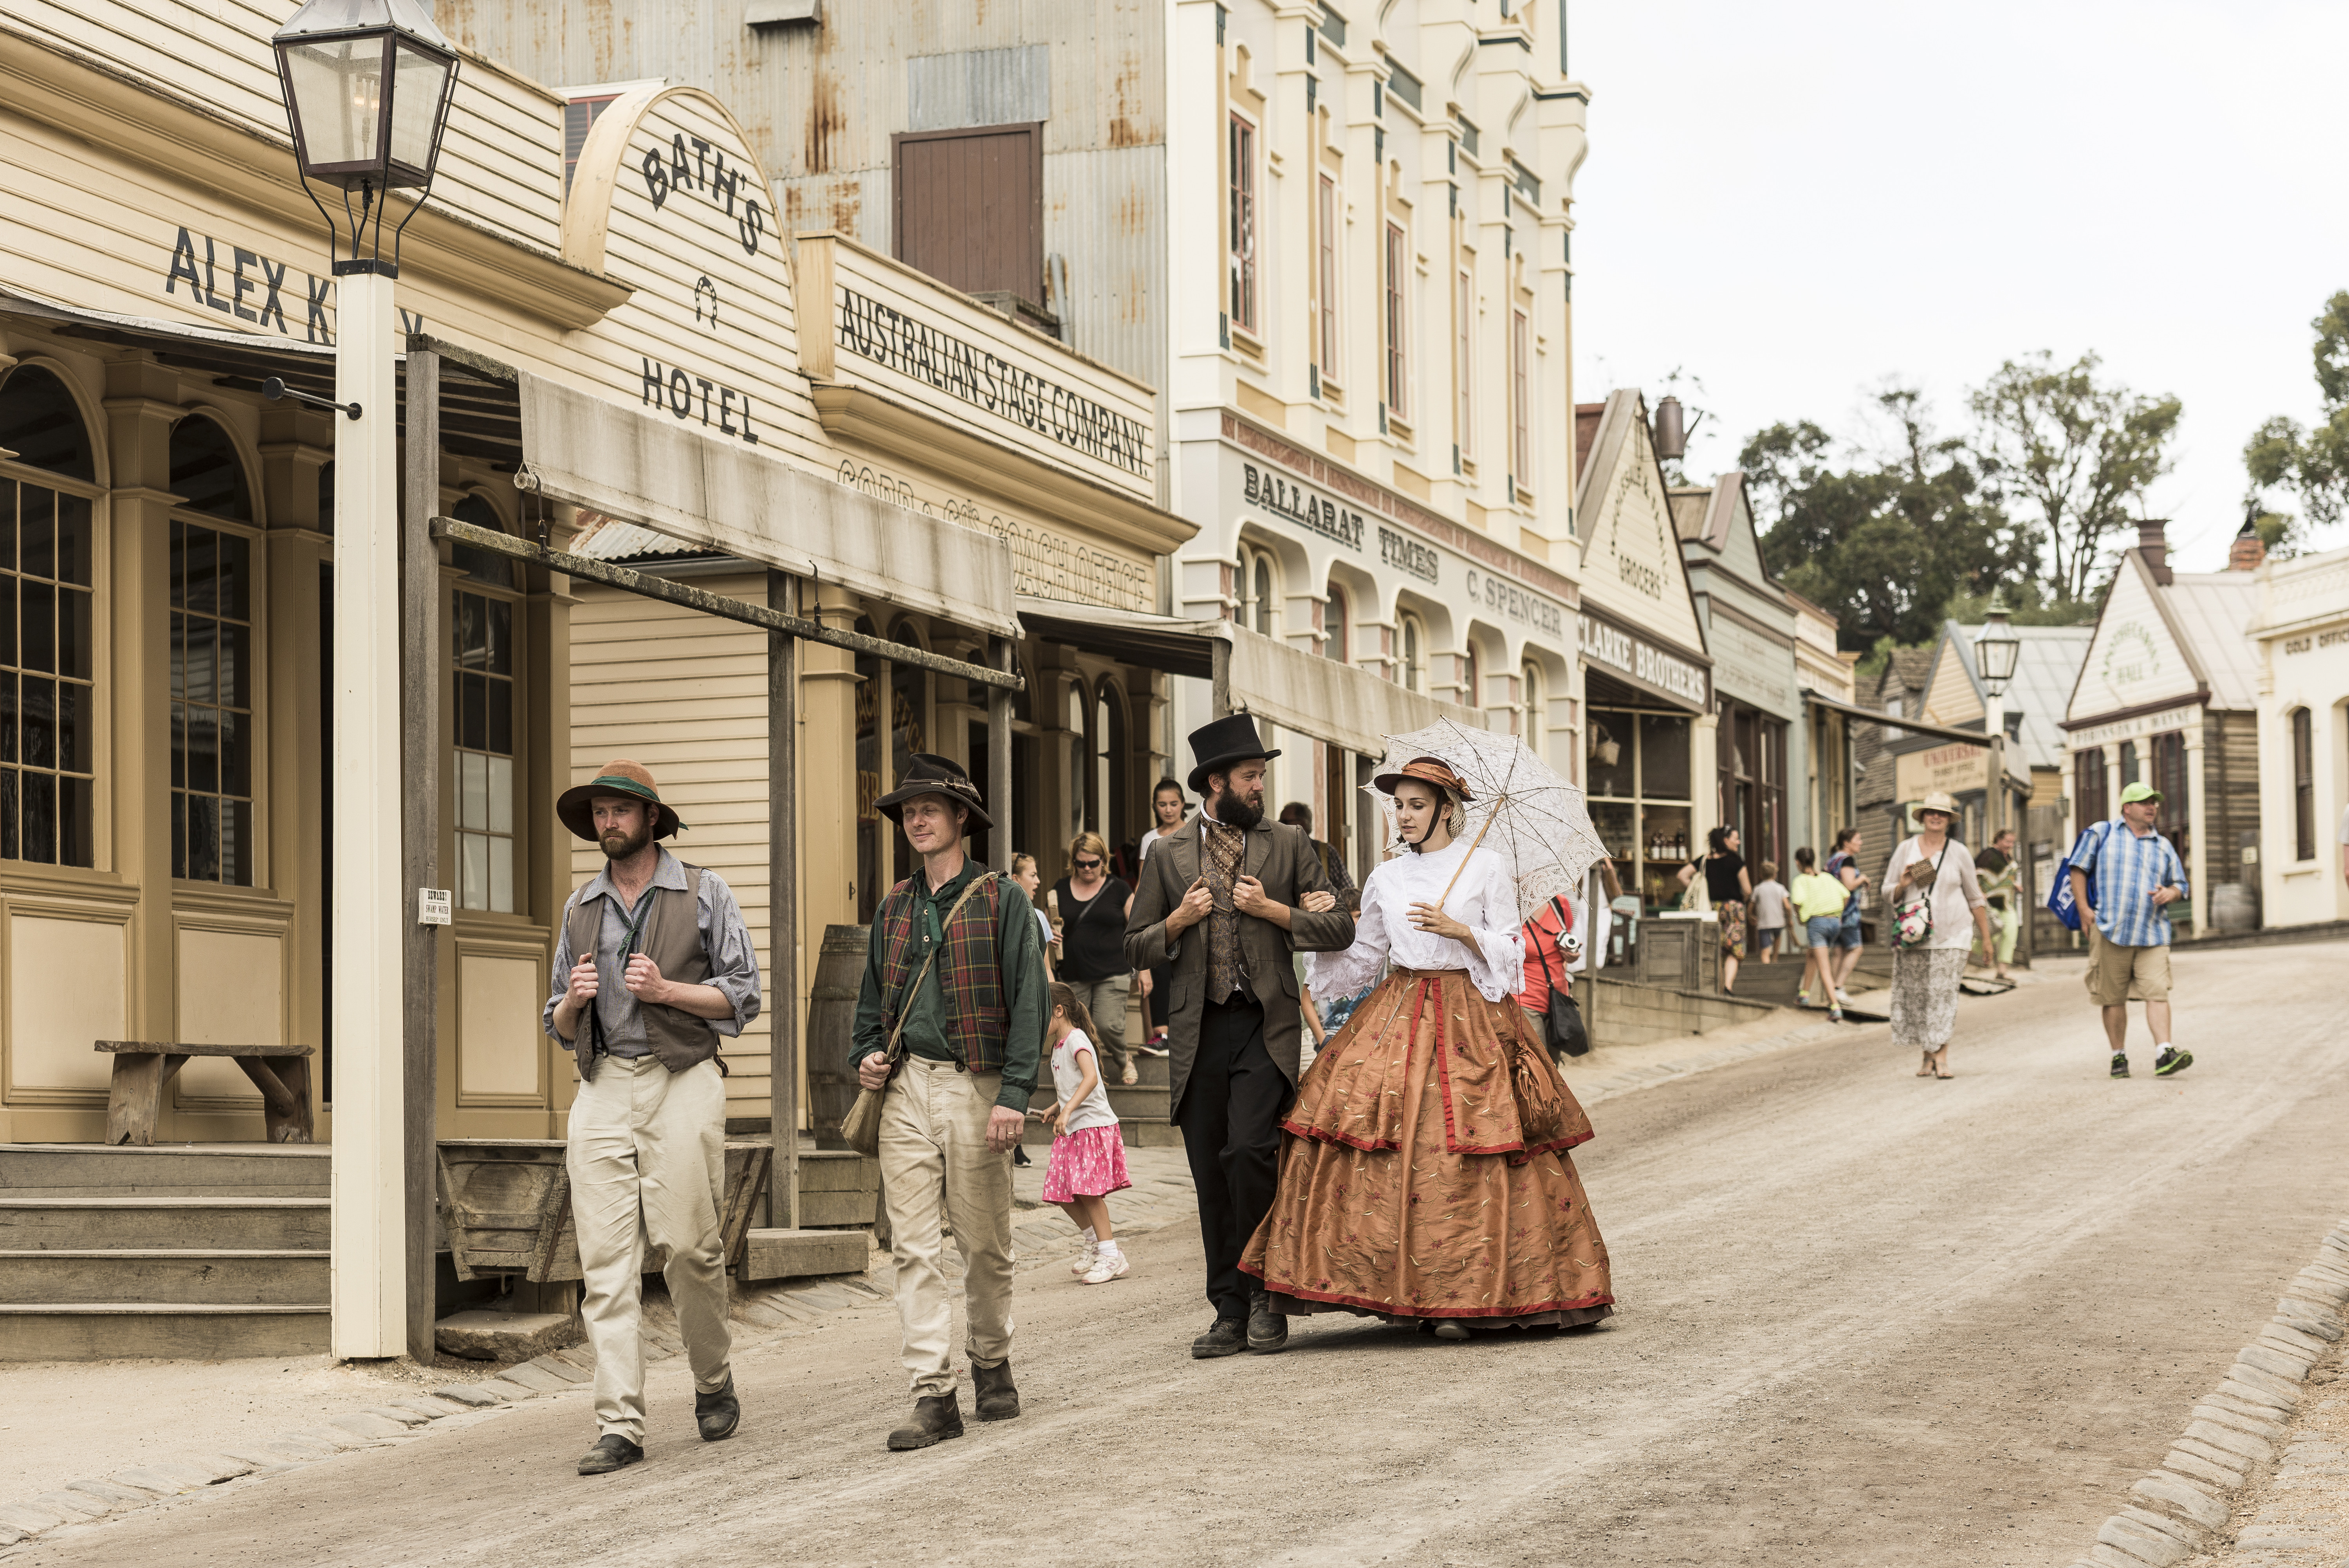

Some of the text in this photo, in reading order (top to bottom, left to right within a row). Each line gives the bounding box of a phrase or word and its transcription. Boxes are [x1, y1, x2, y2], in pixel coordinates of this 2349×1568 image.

[642, 133, 763, 256] BATH'S
[166, 226, 288, 334] ALEX
[643, 357, 758, 445] HOTEL
[842, 289, 977, 403] AUSTRALIAN
[984, 354, 1047, 433] STAGE
[1244, 463, 1439, 585] BALLARAT TIMES
[1485, 577, 1562, 639] SPENCER
[1577, 614, 1632, 673] CLARKE
[1635, 641, 1705, 705] BROTHERS
[426, 904, 448, 914] SWAMP WATER
[428, 890, 446, 901] BEWARE!
